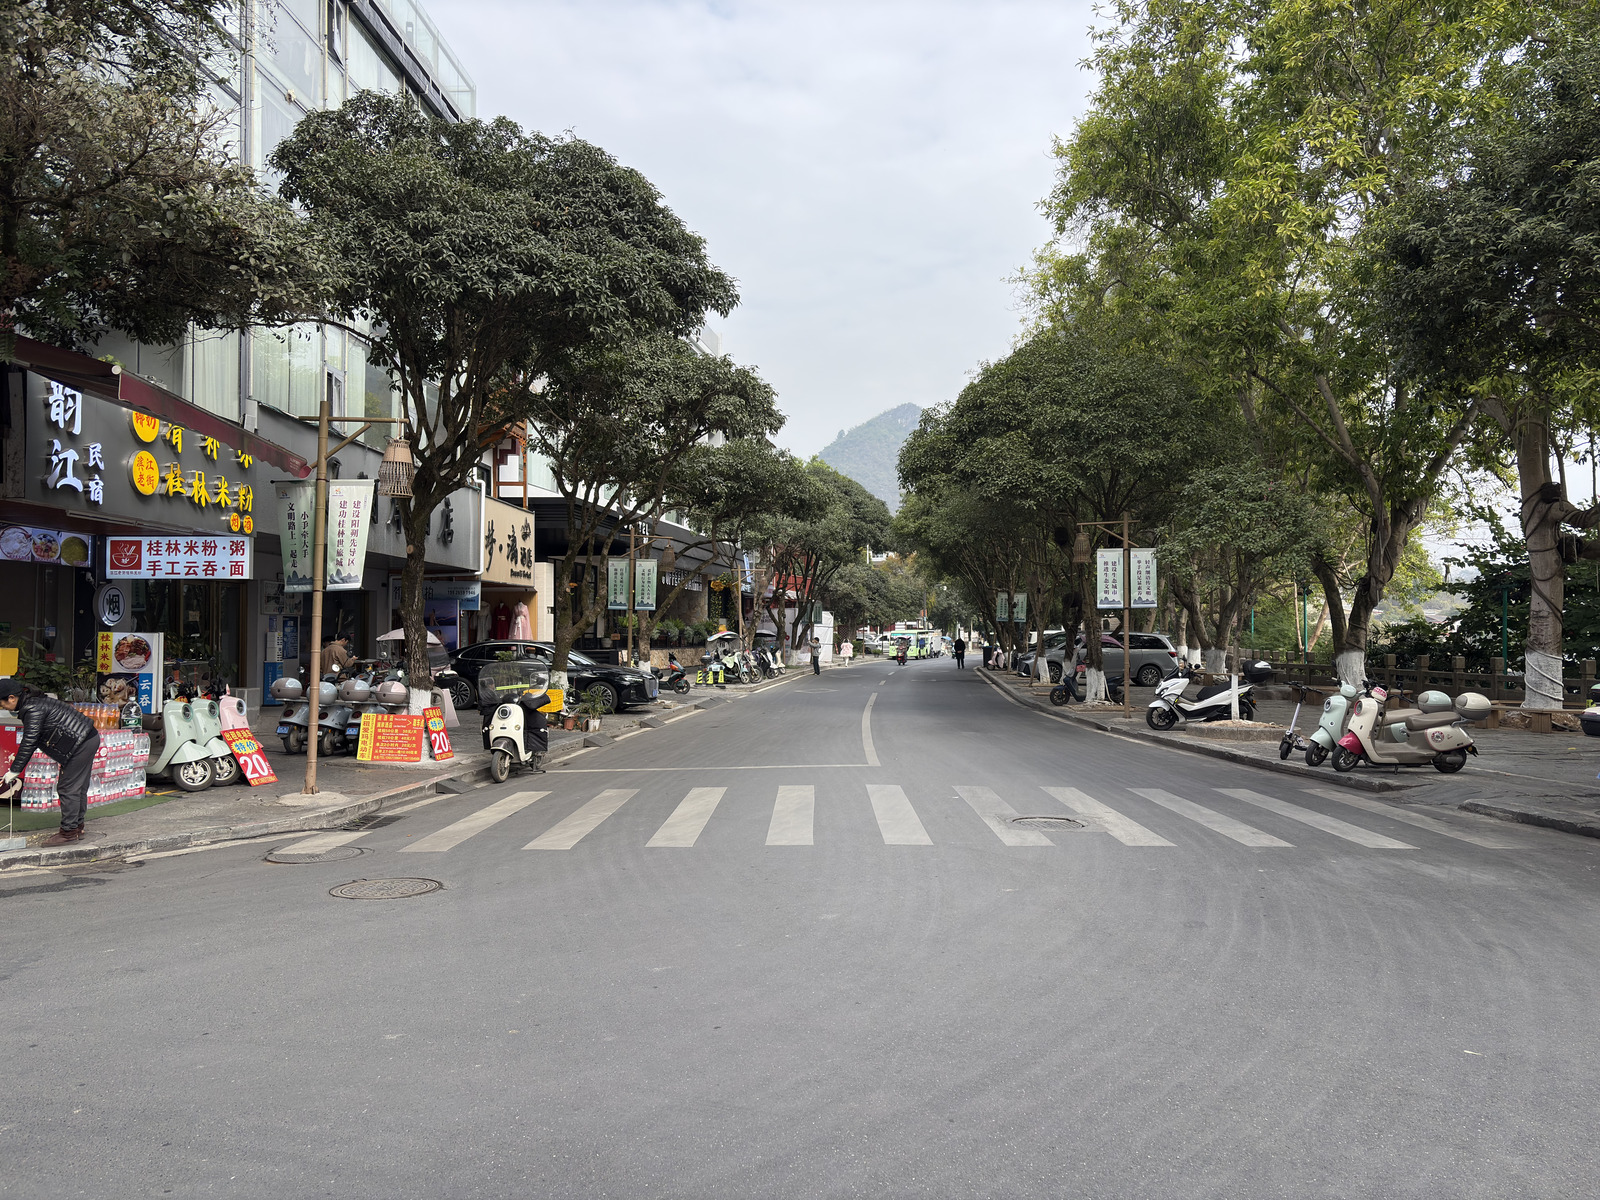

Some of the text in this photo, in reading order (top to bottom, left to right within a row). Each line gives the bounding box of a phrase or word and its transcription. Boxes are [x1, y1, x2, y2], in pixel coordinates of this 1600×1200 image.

[88, 443, 105, 505] 民宿
[165, 463, 253, 512] 桂林米粉
[287, 502, 298, 568] 文明路上一起走
[301, 511, 309, 558] 小手牵大手
[335, 500, 348, 567] 建功桂林世旅城
[347, 500, 361, 567] 建设阳朔先导区
[146, 540, 245, 556] 桂林米粉·粥
[520, 547, 533, 569] 酒店
[146, 560, 245, 576] 手工云吞·面
[106, 594, 121, 616] 烟
[100, 633, 111, 671] 桂林米粉
[139, 679, 152, 707] 云吞
[234, 740, 257, 752] 特价
[431, 731, 449, 754] 20
[239, 754, 269, 779] 20
